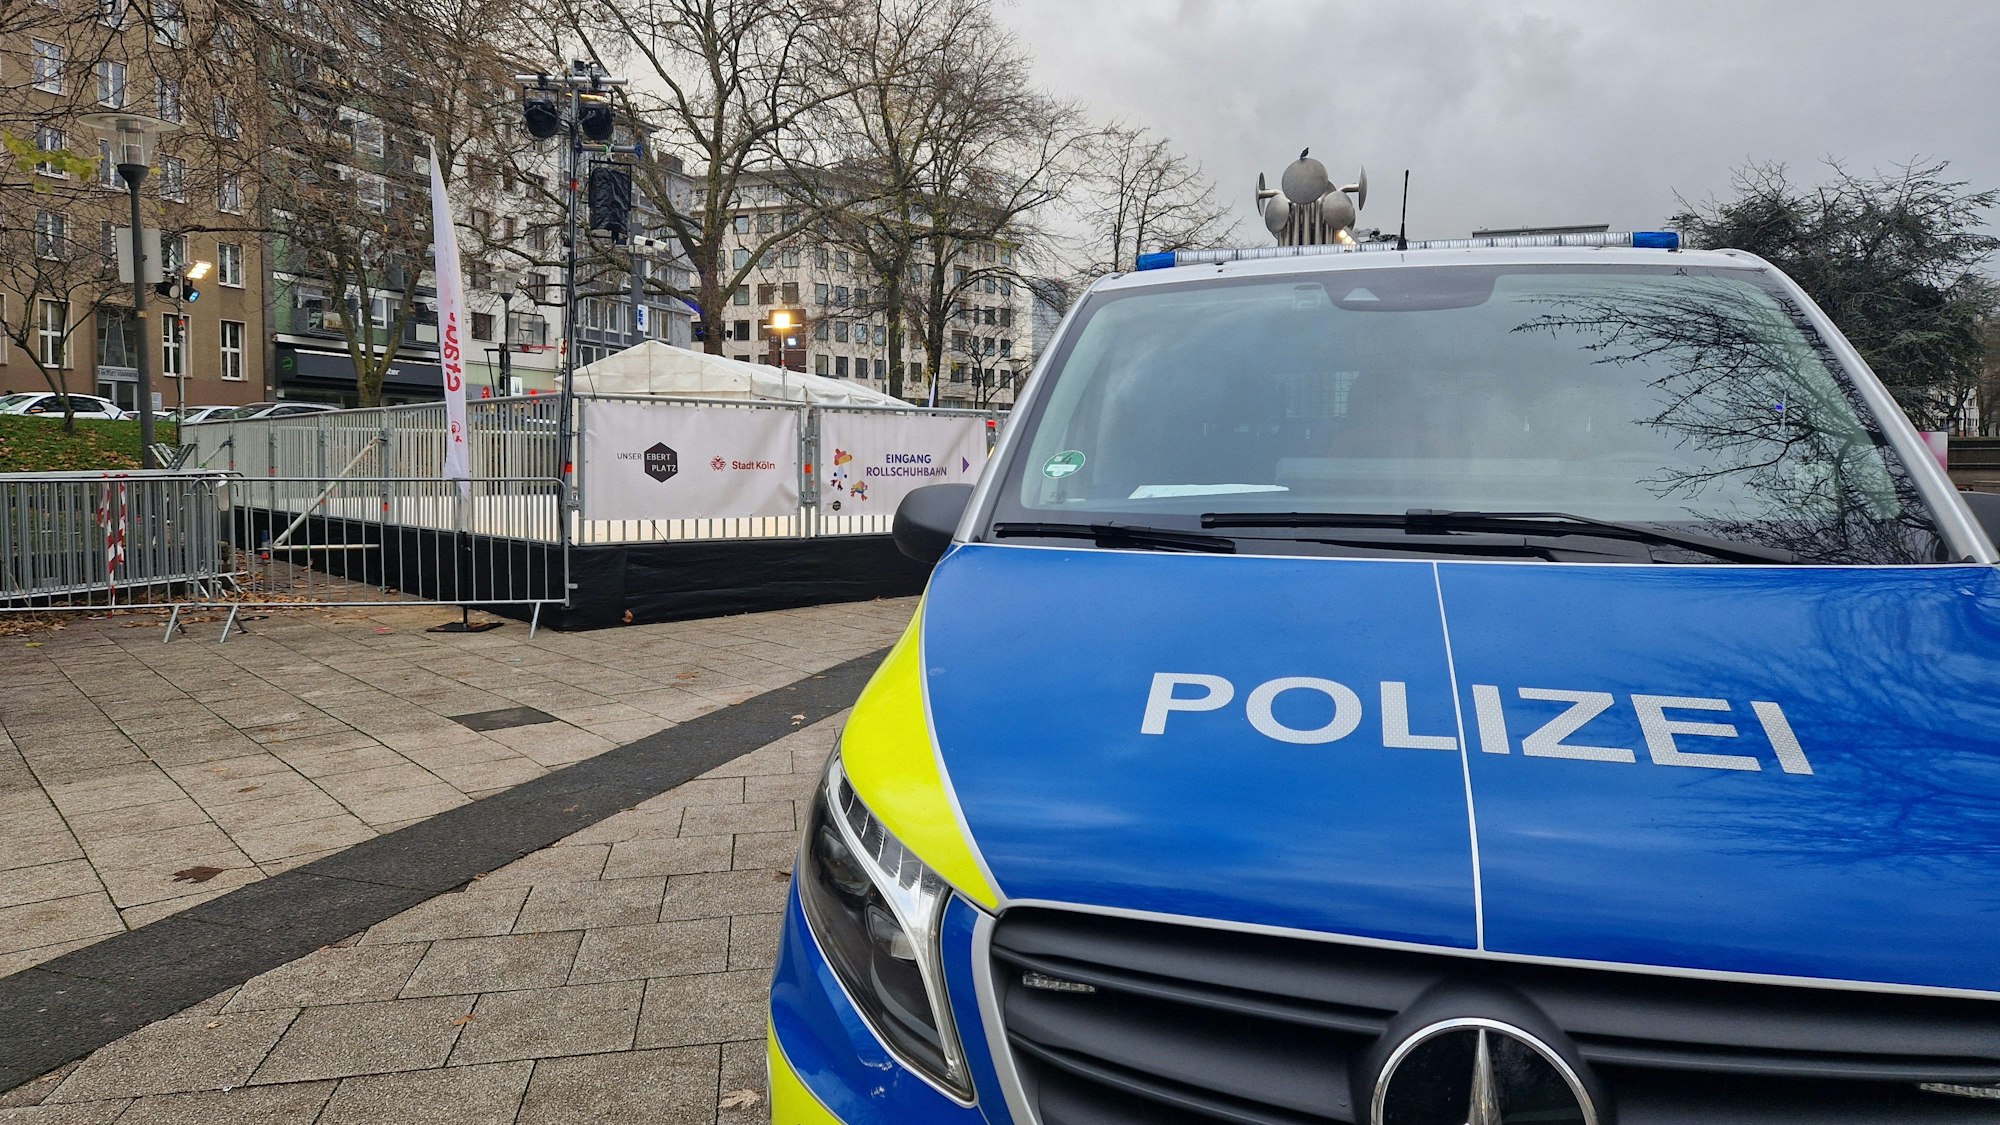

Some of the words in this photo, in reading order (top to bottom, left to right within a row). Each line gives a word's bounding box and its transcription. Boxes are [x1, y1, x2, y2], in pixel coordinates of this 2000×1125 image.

[616, 452, 642, 461] UNSER
[646, 453, 671, 461] EBERT
[885, 454, 932, 464] EINGANG
[651, 464, 677, 473] PLATZ
[732, 460, 755, 470] Stadt
[756, 460, 775, 470] Köln
[866, 466, 947, 477] ROLLSCHUHBAHN
[1141, 672, 1814, 775] POLIZEI
